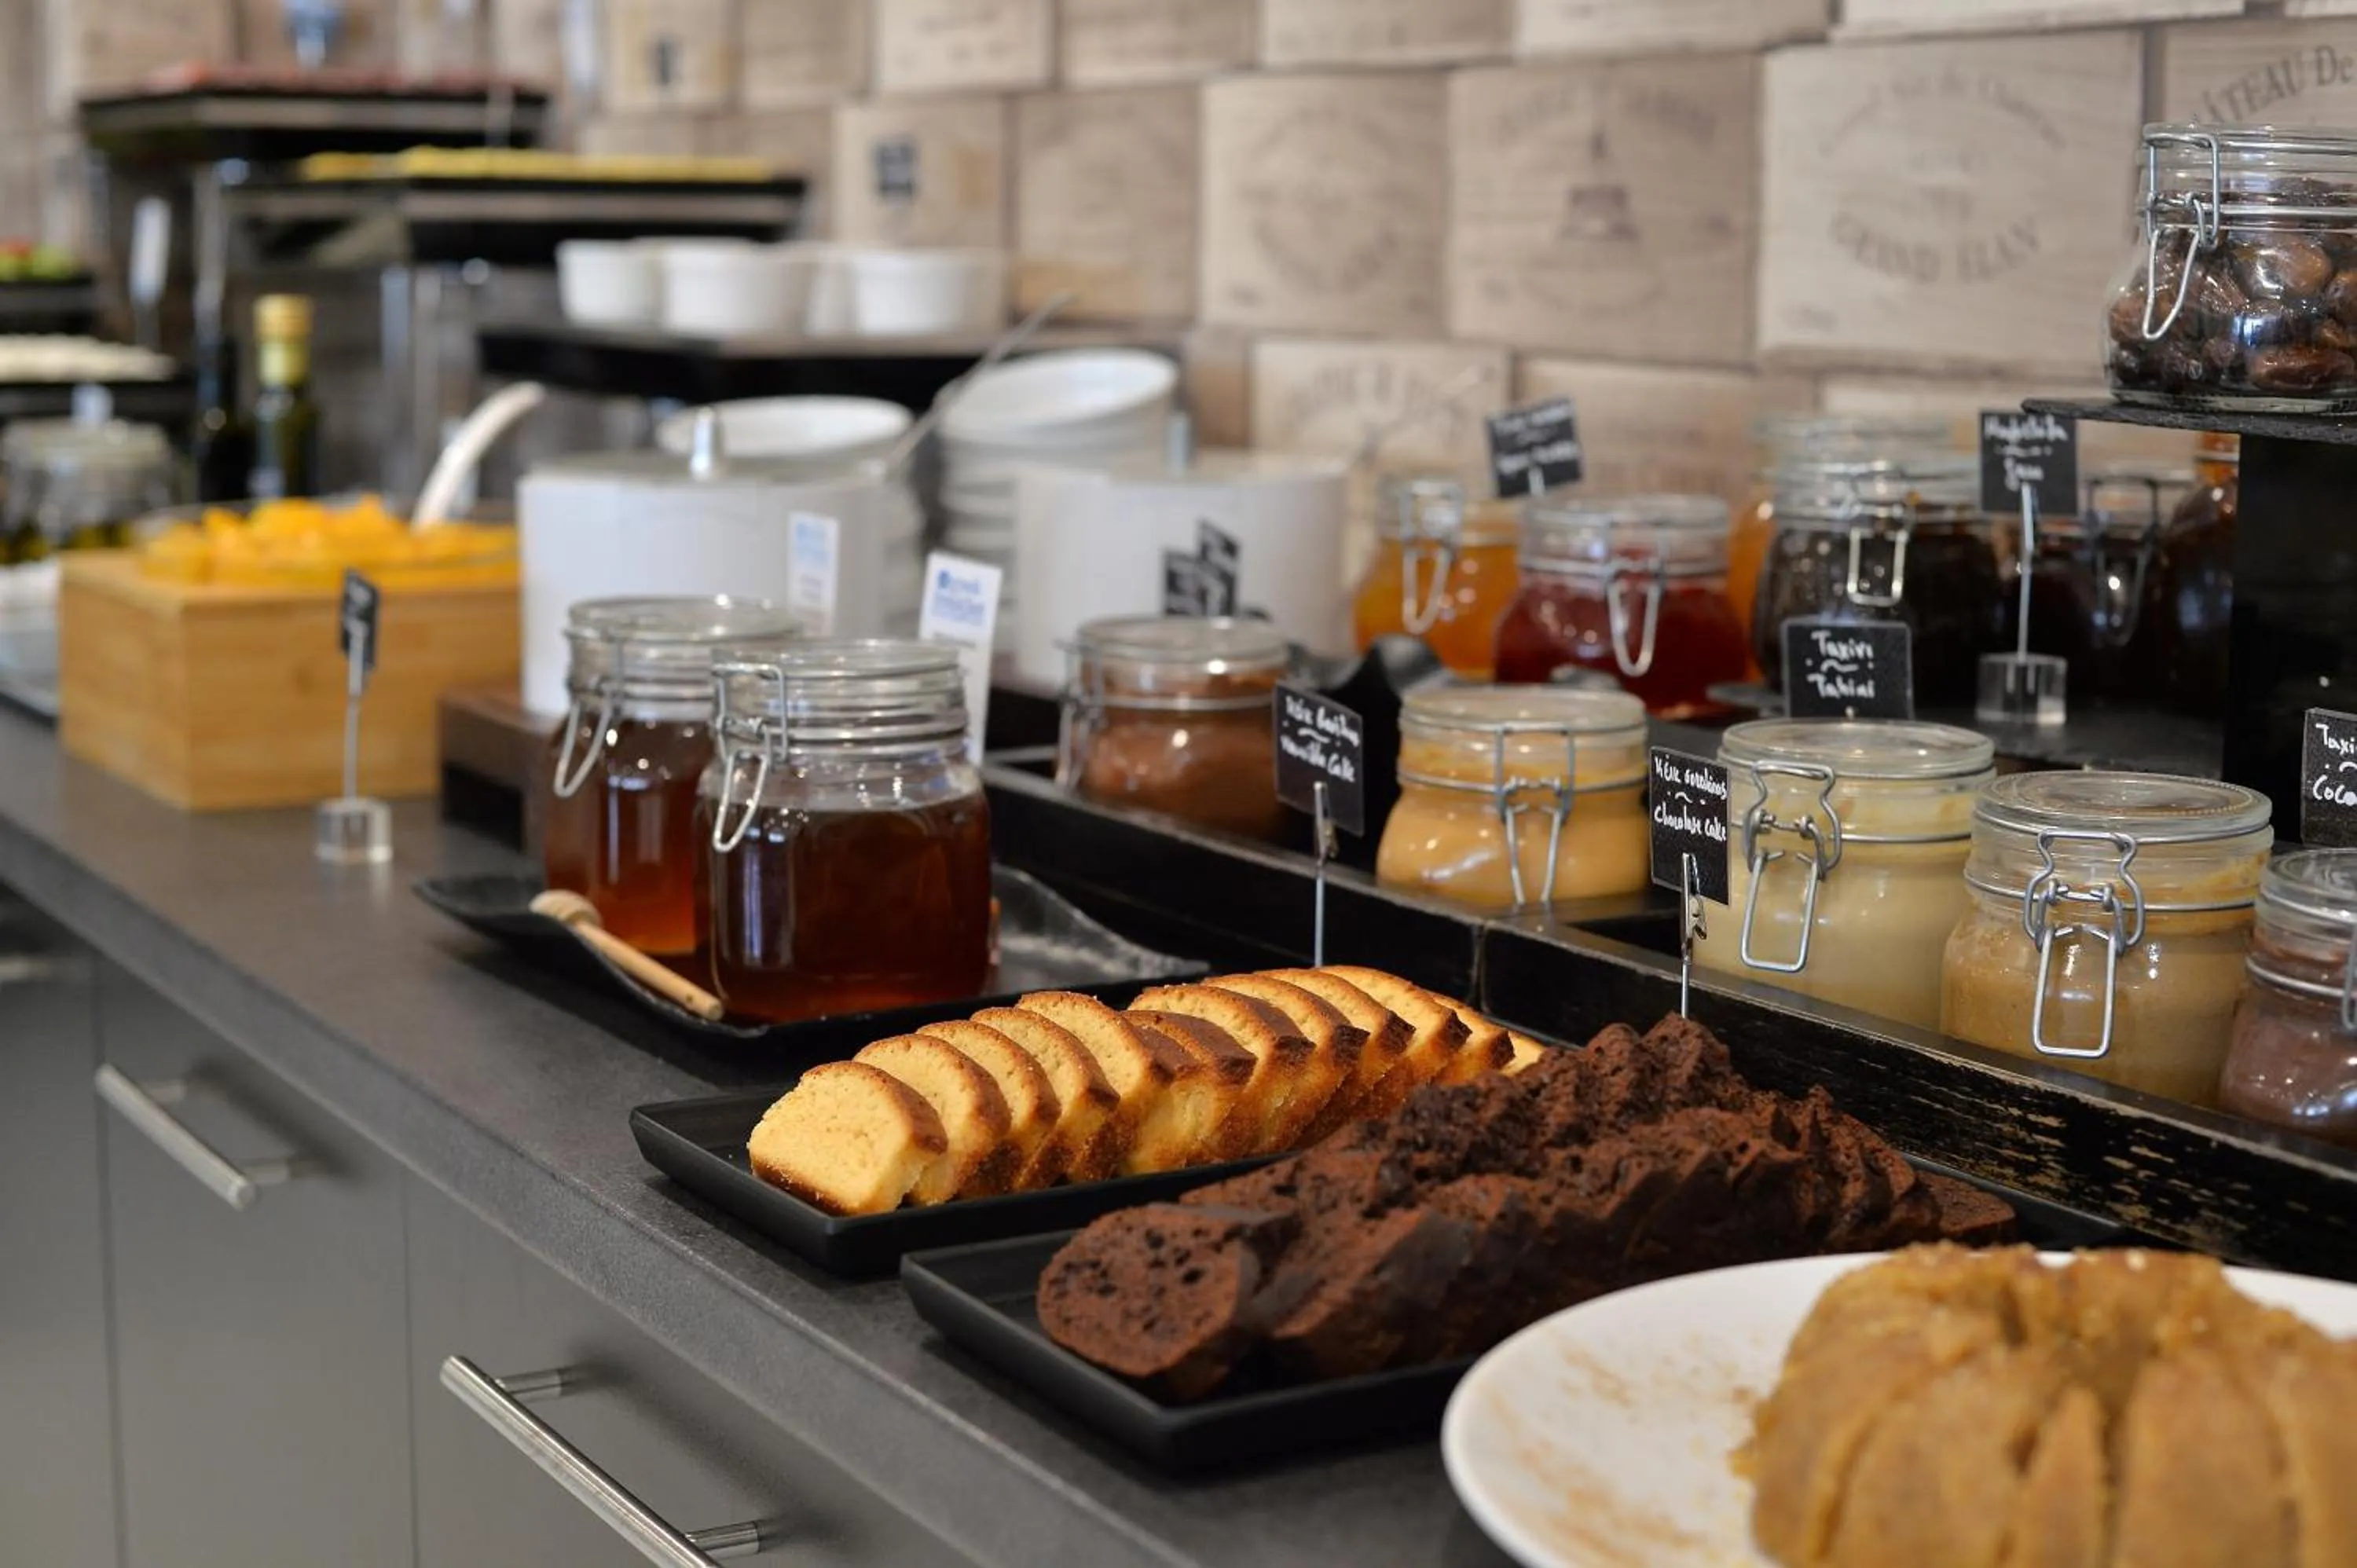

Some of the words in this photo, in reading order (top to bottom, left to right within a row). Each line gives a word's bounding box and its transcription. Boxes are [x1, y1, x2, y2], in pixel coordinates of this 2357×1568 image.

[1807, 673, 1875, 699] Tahini
[2315, 722, 2357, 756] Ταχί
[2312, 774, 2357, 807] Coco
